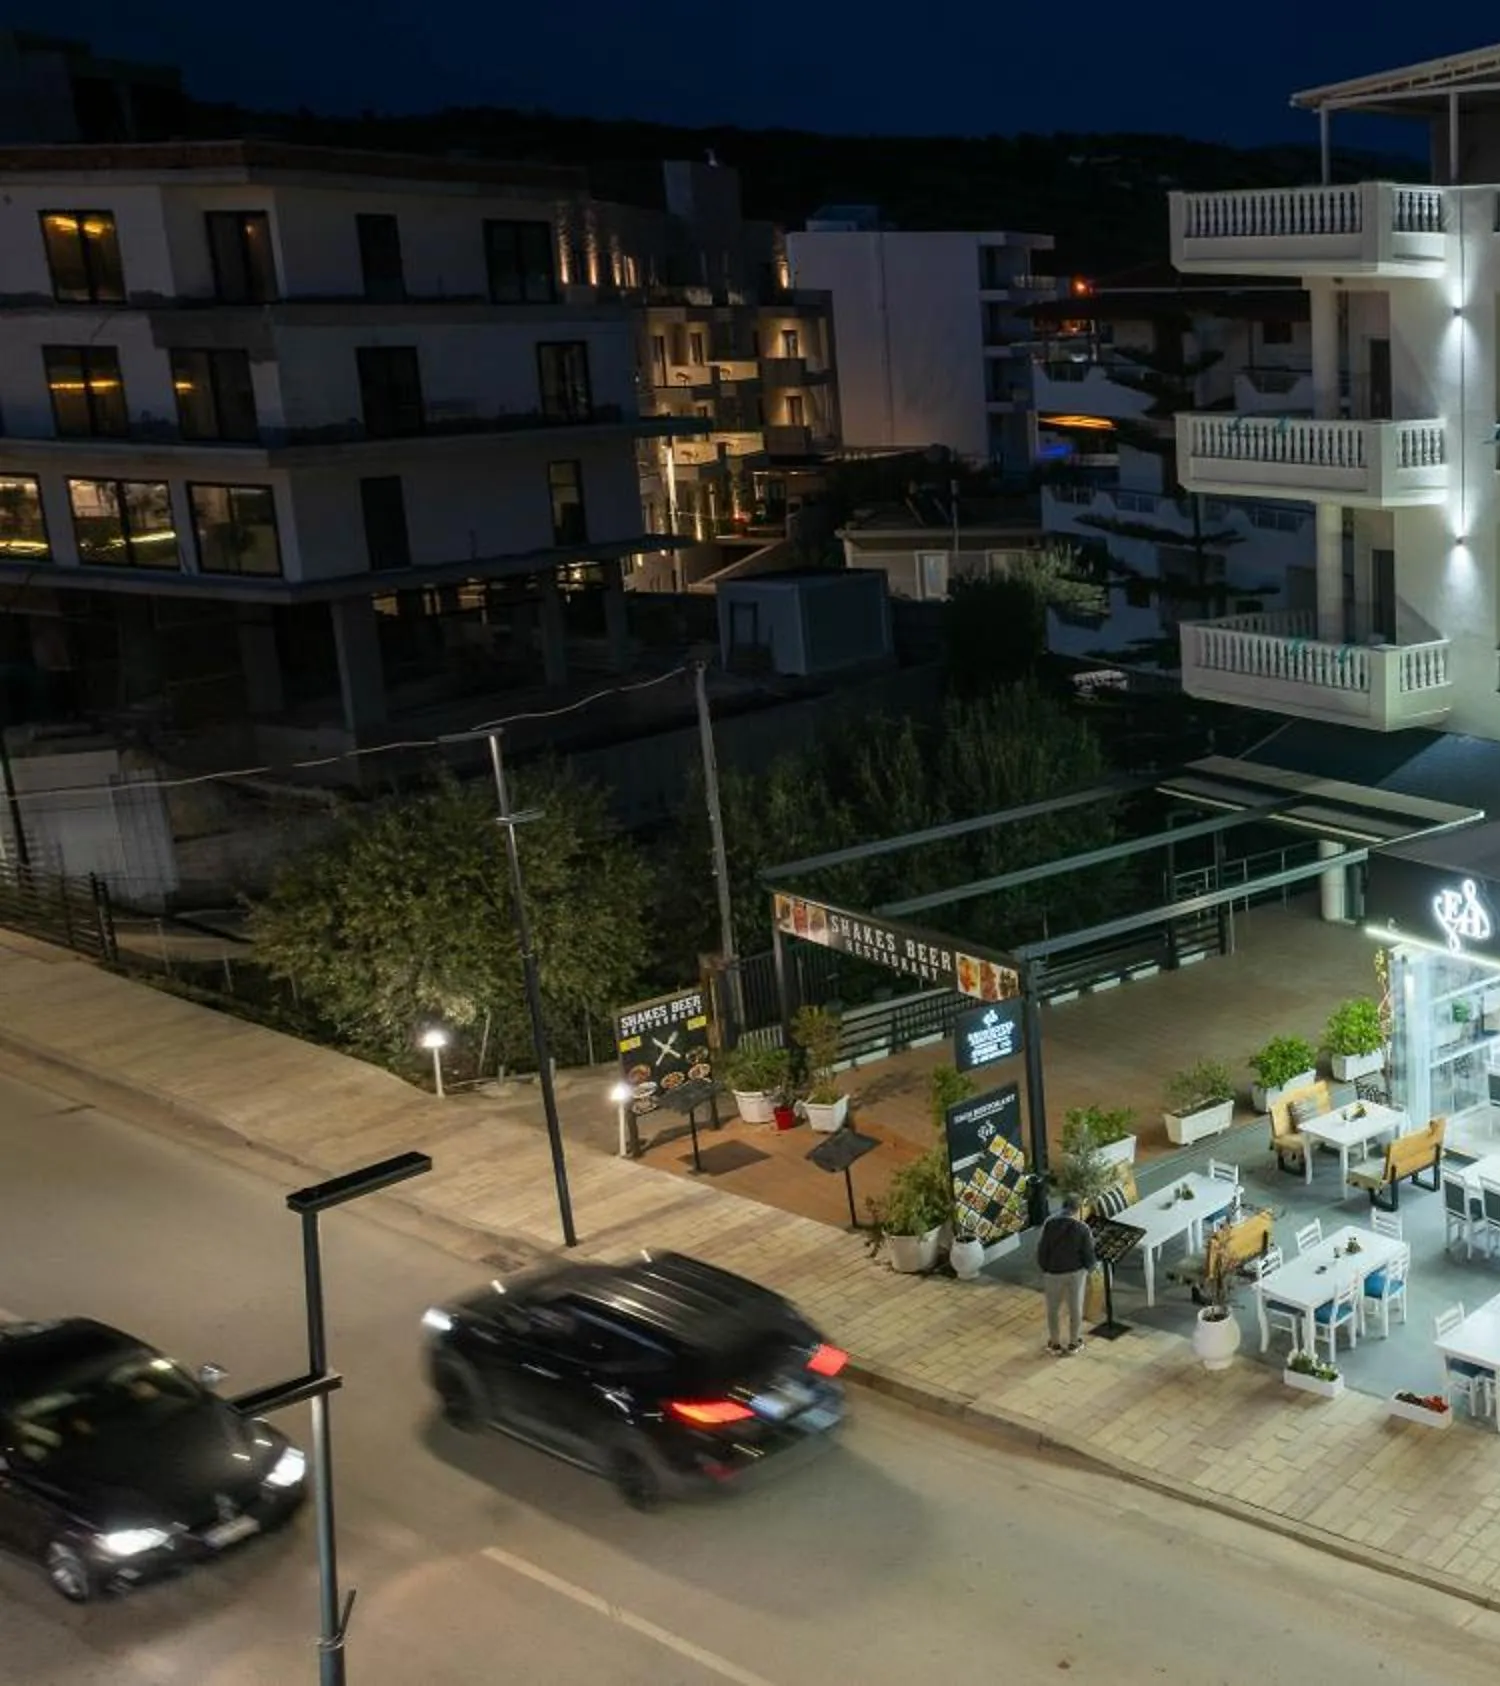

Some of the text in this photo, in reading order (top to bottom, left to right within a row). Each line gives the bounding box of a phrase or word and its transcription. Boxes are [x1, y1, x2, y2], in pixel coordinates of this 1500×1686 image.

[830, 914, 953, 973] SHAKES BEER
[621, 995, 701, 1030] SHAKES BEER
